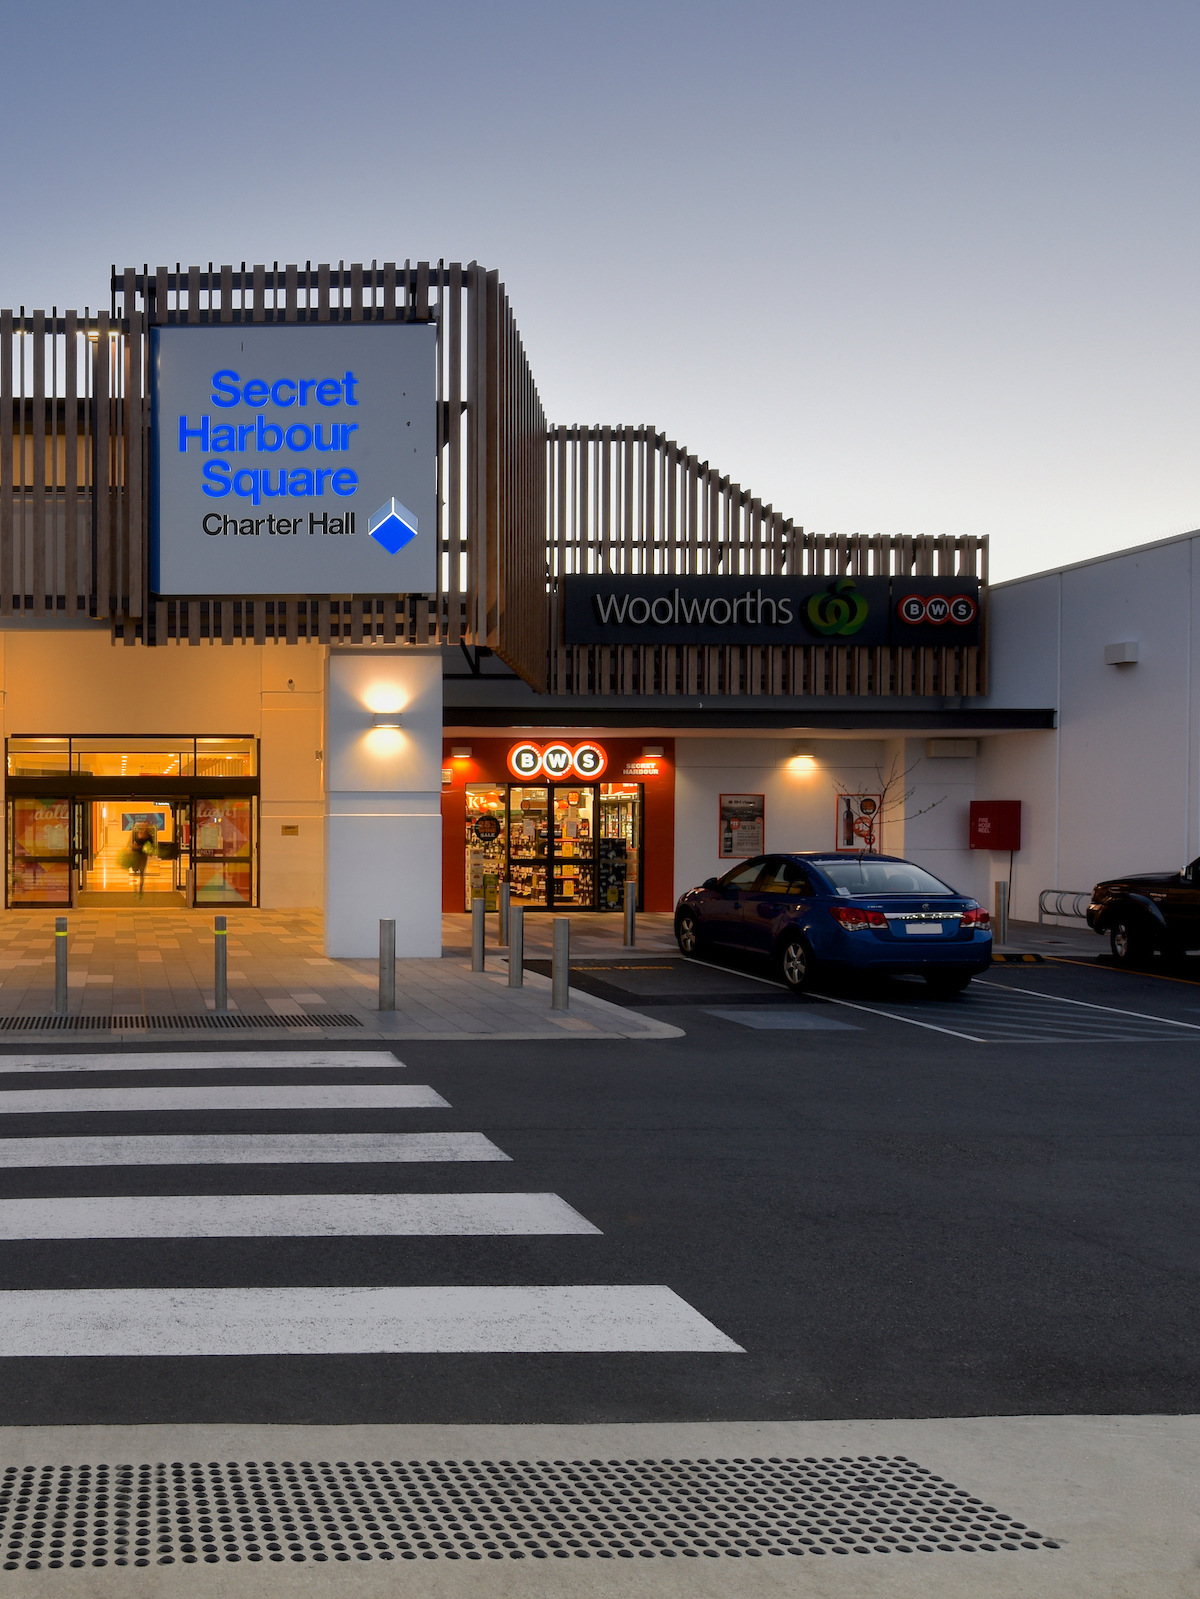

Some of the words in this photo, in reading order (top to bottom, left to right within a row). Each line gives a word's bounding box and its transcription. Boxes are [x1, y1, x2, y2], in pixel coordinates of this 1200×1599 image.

[211, 369, 359, 408] Secret
[178, 414, 359, 453] Harbour
[201, 459, 359, 506] Square
[202, 513, 303, 536] Charter
[308, 512, 356, 535] Hall
[596, 588, 794, 625] Woolworths
